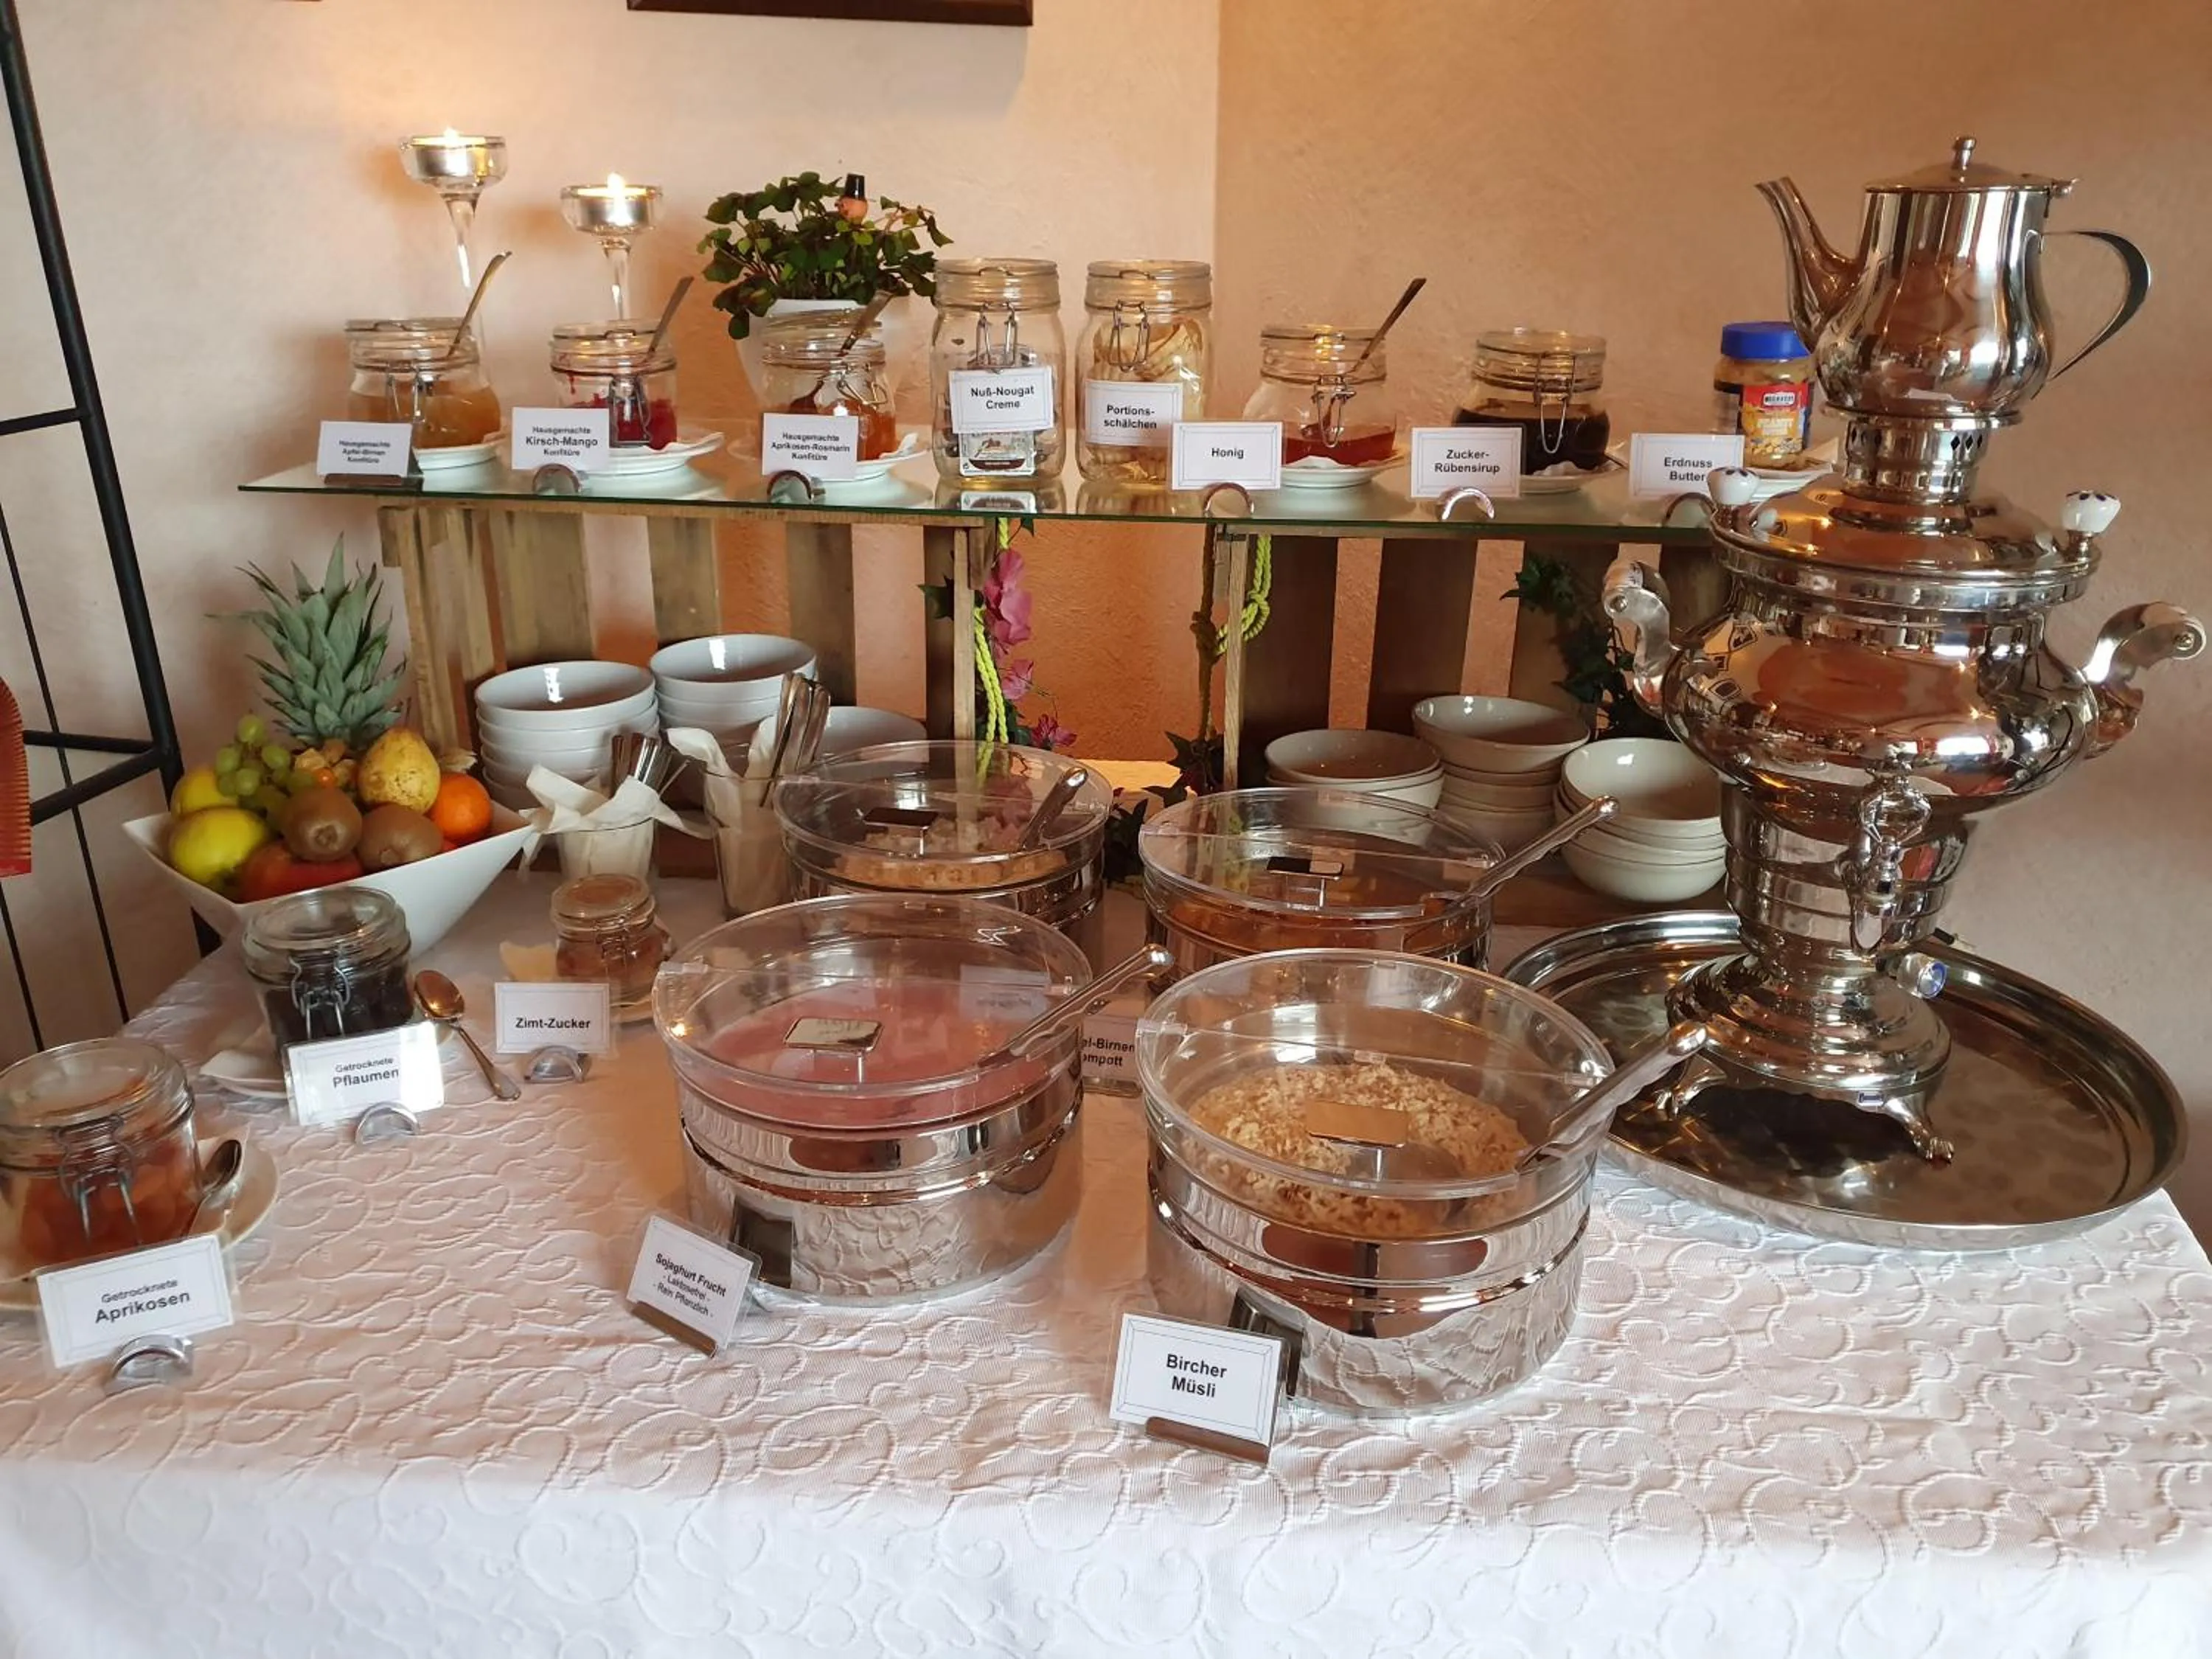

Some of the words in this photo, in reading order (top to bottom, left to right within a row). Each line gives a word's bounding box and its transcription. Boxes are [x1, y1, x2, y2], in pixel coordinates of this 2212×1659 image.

[970, 386, 1034, 397] Nuß-Nougat
[986, 400, 1020, 409] Creme
[1107, 404, 1155, 415] Portions-
[1104, 419, 1157, 429] schälchen
[532, 426, 591, 435] Hausgemachte
[526, 437, 598, 448] Kirsch-Mango
[782, 432, 840, 442] Hausgemachte
[543, 448, 580, 456] Konfitüre
[771, 442, 850, 452] Aprikosen-Rosmarin
[1211, 448, 1244, 459] Honig
[1446, 449, 1489, 459] Zucker-
[1664, 457, 1713, 468] Erdnuss
[1434, 462, 1500, 476] Rübensirup
[1669, 470, 1705, 481] Butter
[516, 1017, 591, 1029] Zimt-Zucker
[1081, 1037, 1135, 1053] el-Birnen
[1082, 1054, 1123, 1067] mpott
[333, 1069, 399, 1088] Pflaumen
[655, 1253, 697, 1281] Sojaghurt
[698, 1274, 726, 1298] Frucht
[101, 1278, 178, 1303] Getrocknete
[94, 1291, 191, 1324] Aprikosen
[1166, 1353, 1227, 1378] Bircher
[1172, 1375, 1216, 1398] Müsli
